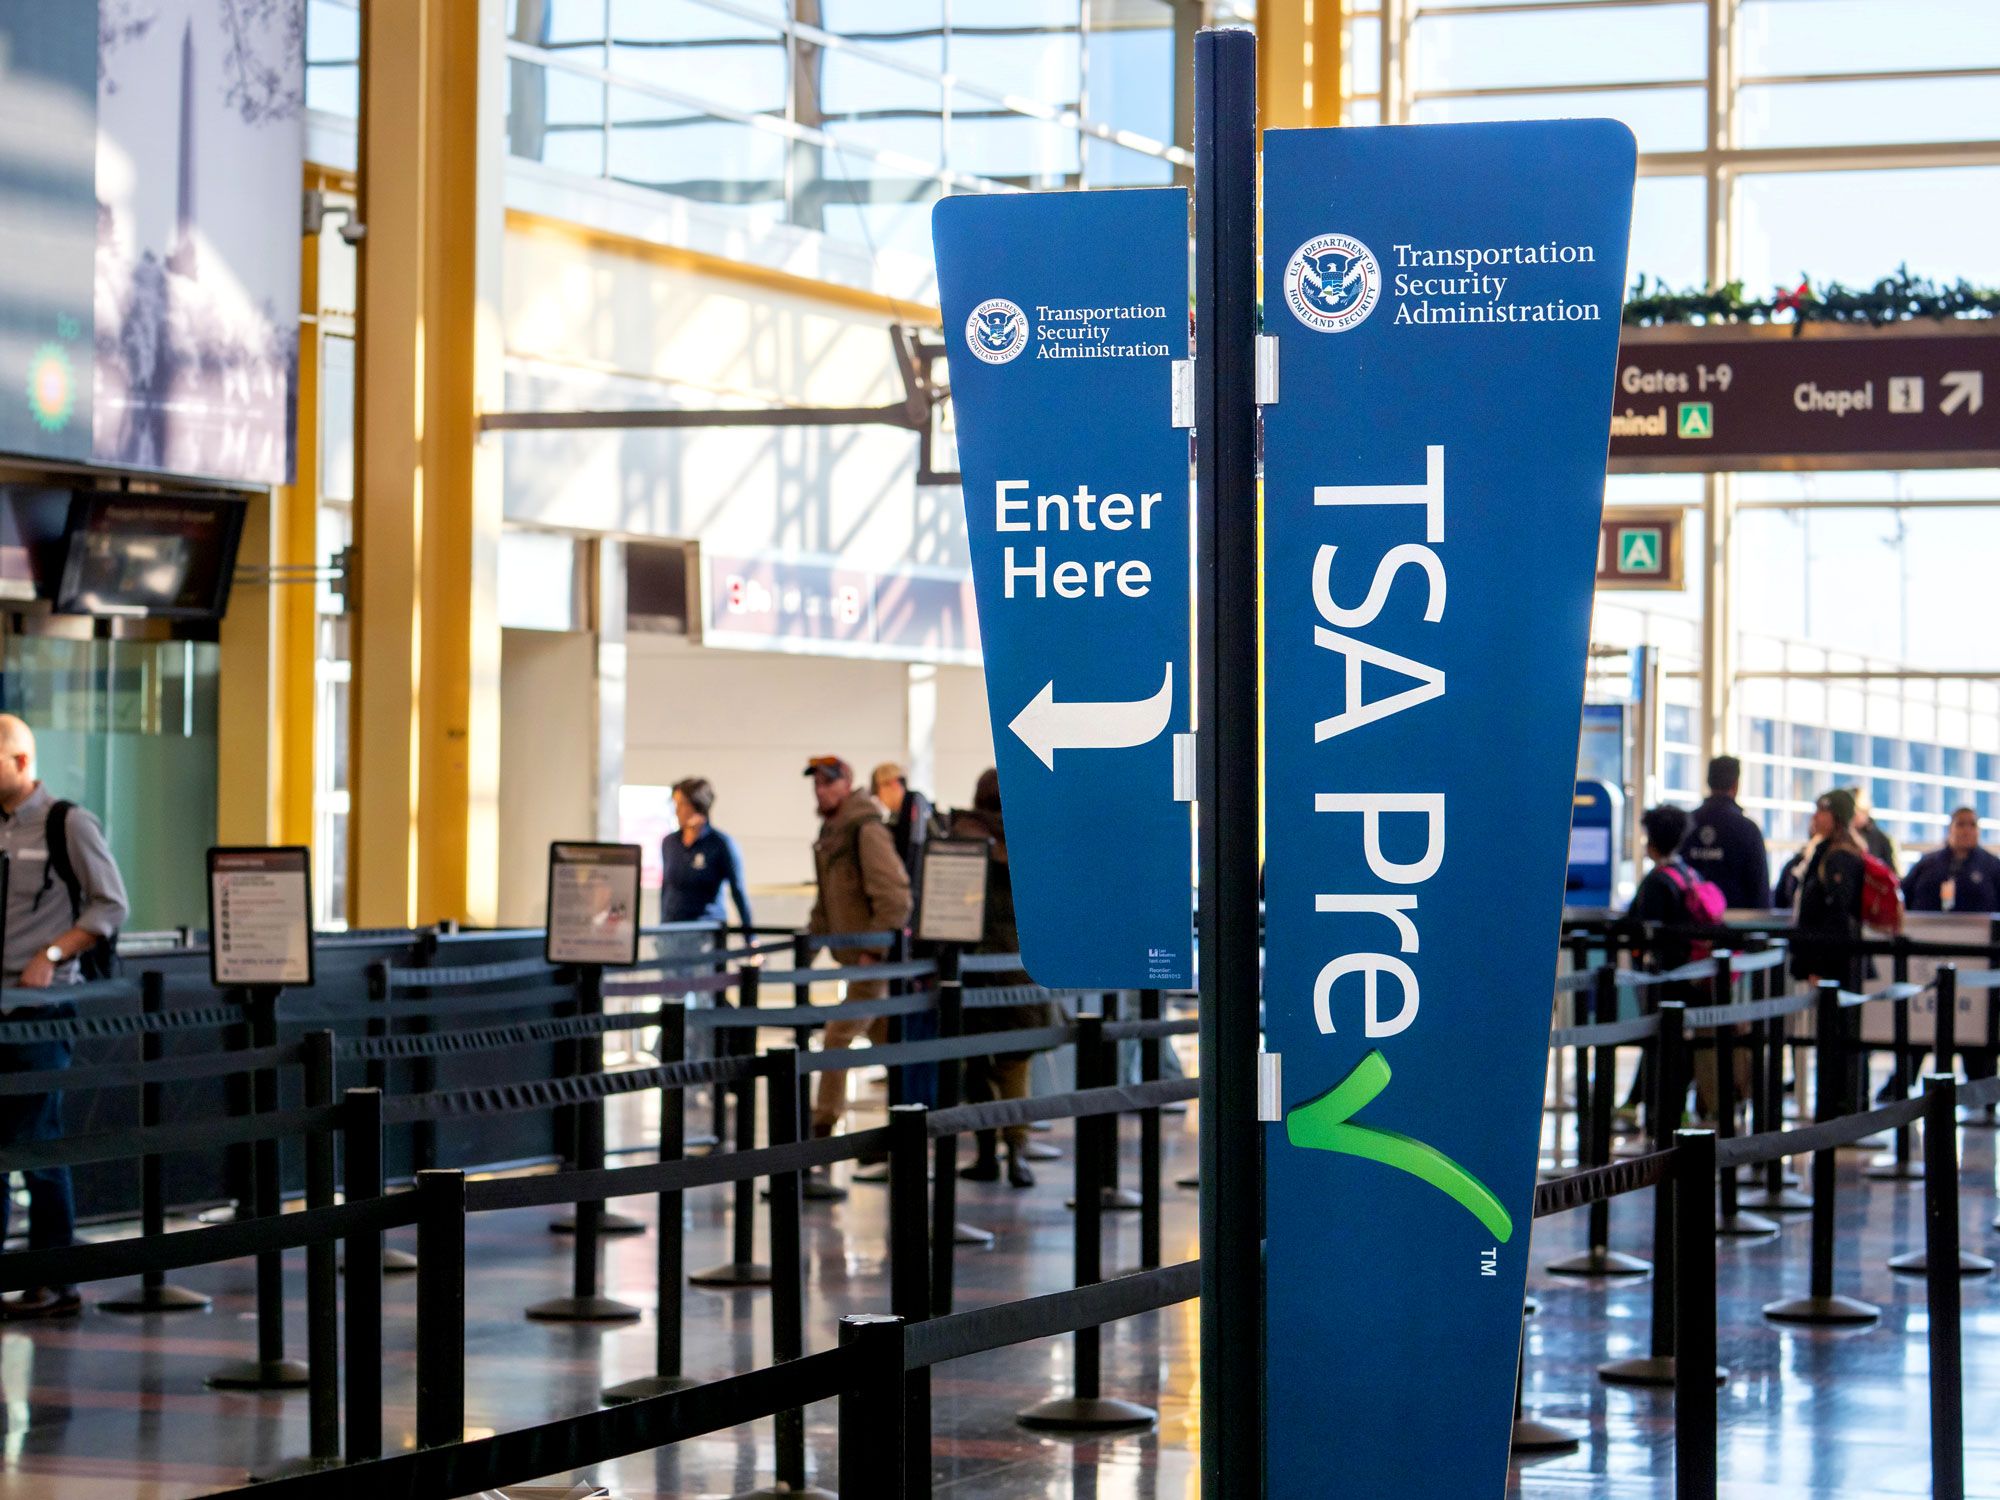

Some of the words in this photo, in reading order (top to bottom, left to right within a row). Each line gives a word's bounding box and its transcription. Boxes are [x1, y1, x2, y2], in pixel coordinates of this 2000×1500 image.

[1304, 238, 1370, 262] DEPARTMENT
[1365, 261, 1377, 276] OF
[1393, 241, 1596, 272] Transportation
[1394, 272, 1507, 301] Security
[978, 301, 1021, 317] DEPARTMENT
[1018, 316, 1026, 327] OF
[1036, 303, 1167, 325] Transportation
[1289, 288, 1335, 329] HOMELAND
[1339, 286, 1377, 328] SECURITY
[1393, 299, 1601, 325] Administration
[969, 334, 999, 361] HOMELAND
[1001, 333, 1026, 360] SECURITY
[1037, 324, 1111, 344] Security
[1036, 341, 1170, 359] Administration
[1622, 365, 1689, 394] Gates
[1696, 363, 1733, 392] 1-9
[1794, 380, 1873, 417] Chapel
[1682, 406, 1709, 436] A
[996, 480, 1162, 532] Enter
[1623, 532, 1656, 570] A
[1004, 546, 1152, 599] Here
[1312, 445, 1447, 744] TSA
[1313, 793, 1446, 1038] Pre
[1481, 1247, 1497, 1276] TM
